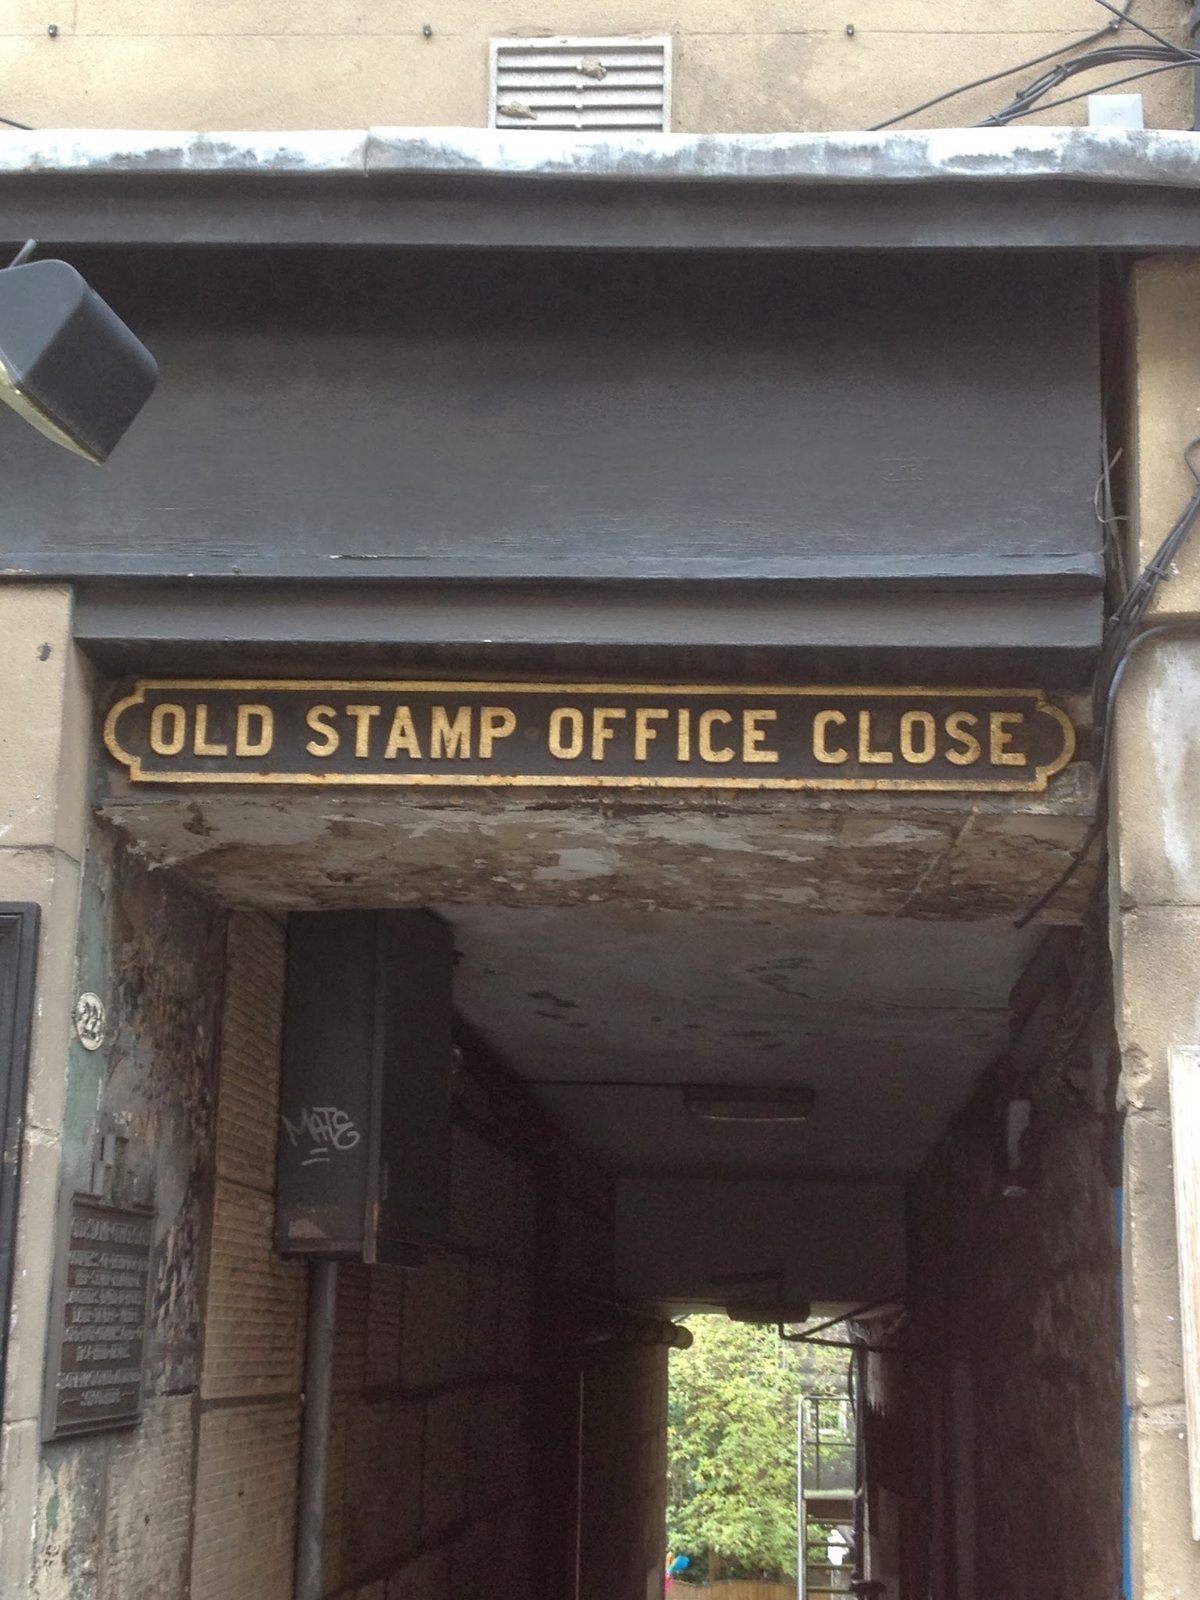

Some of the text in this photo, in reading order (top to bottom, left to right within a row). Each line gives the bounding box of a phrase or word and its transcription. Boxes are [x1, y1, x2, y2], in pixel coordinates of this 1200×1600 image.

[150, 703, 1027, 766] OLD STAMP OFFICE CLOSE
